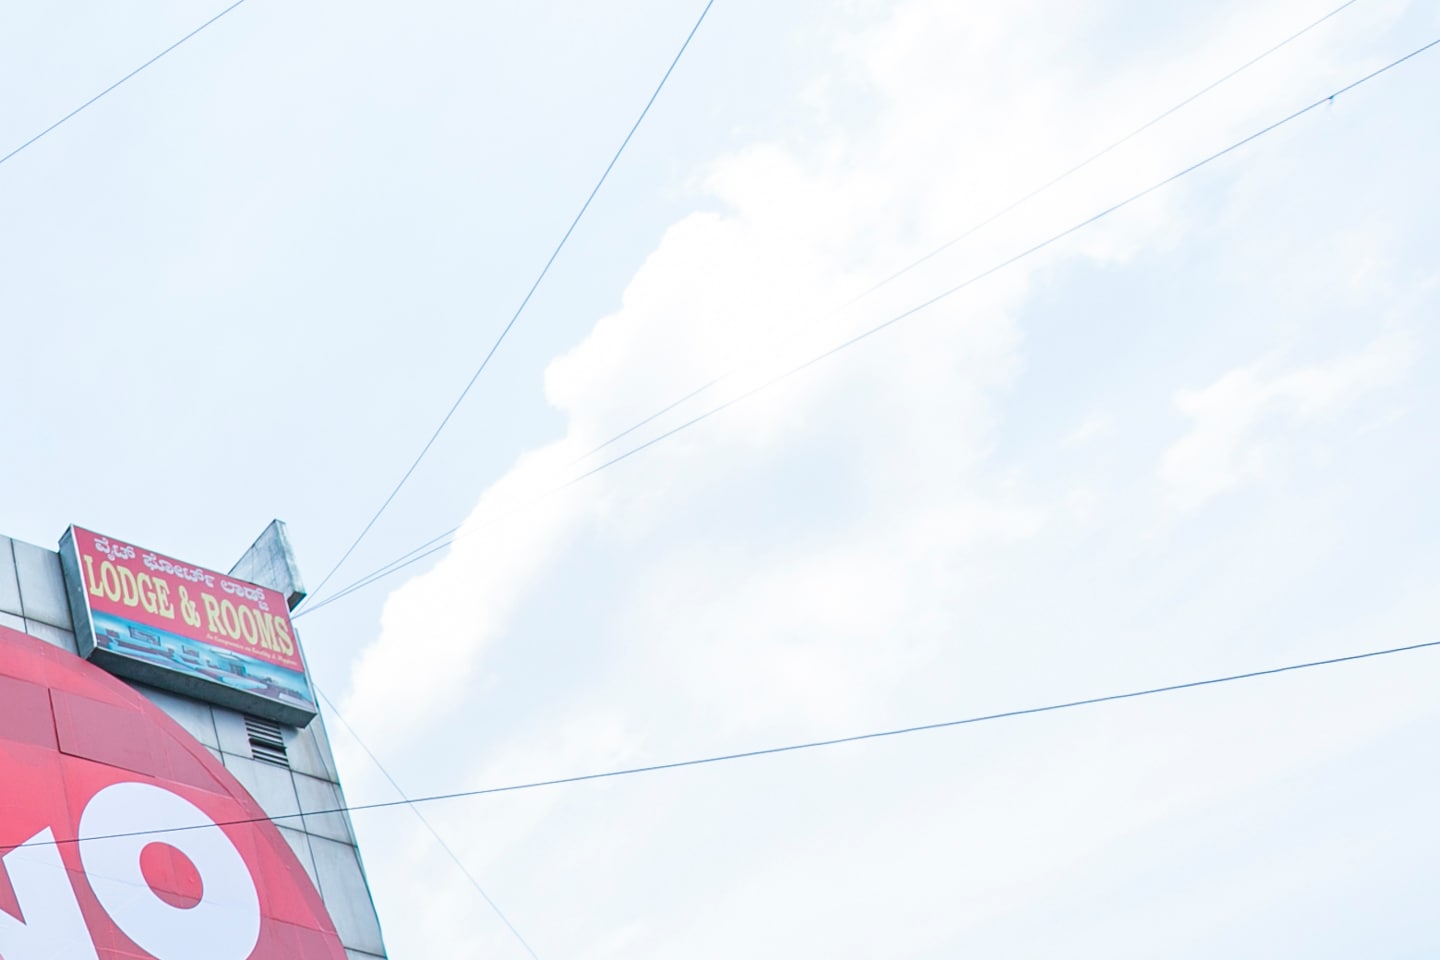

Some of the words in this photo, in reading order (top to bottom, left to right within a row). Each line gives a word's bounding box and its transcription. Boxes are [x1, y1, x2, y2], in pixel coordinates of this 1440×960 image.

[83, 554, 175, 620] LODGE
[178, 585, 201, 628] &
[201, 592, 294, 657] ROOMS
